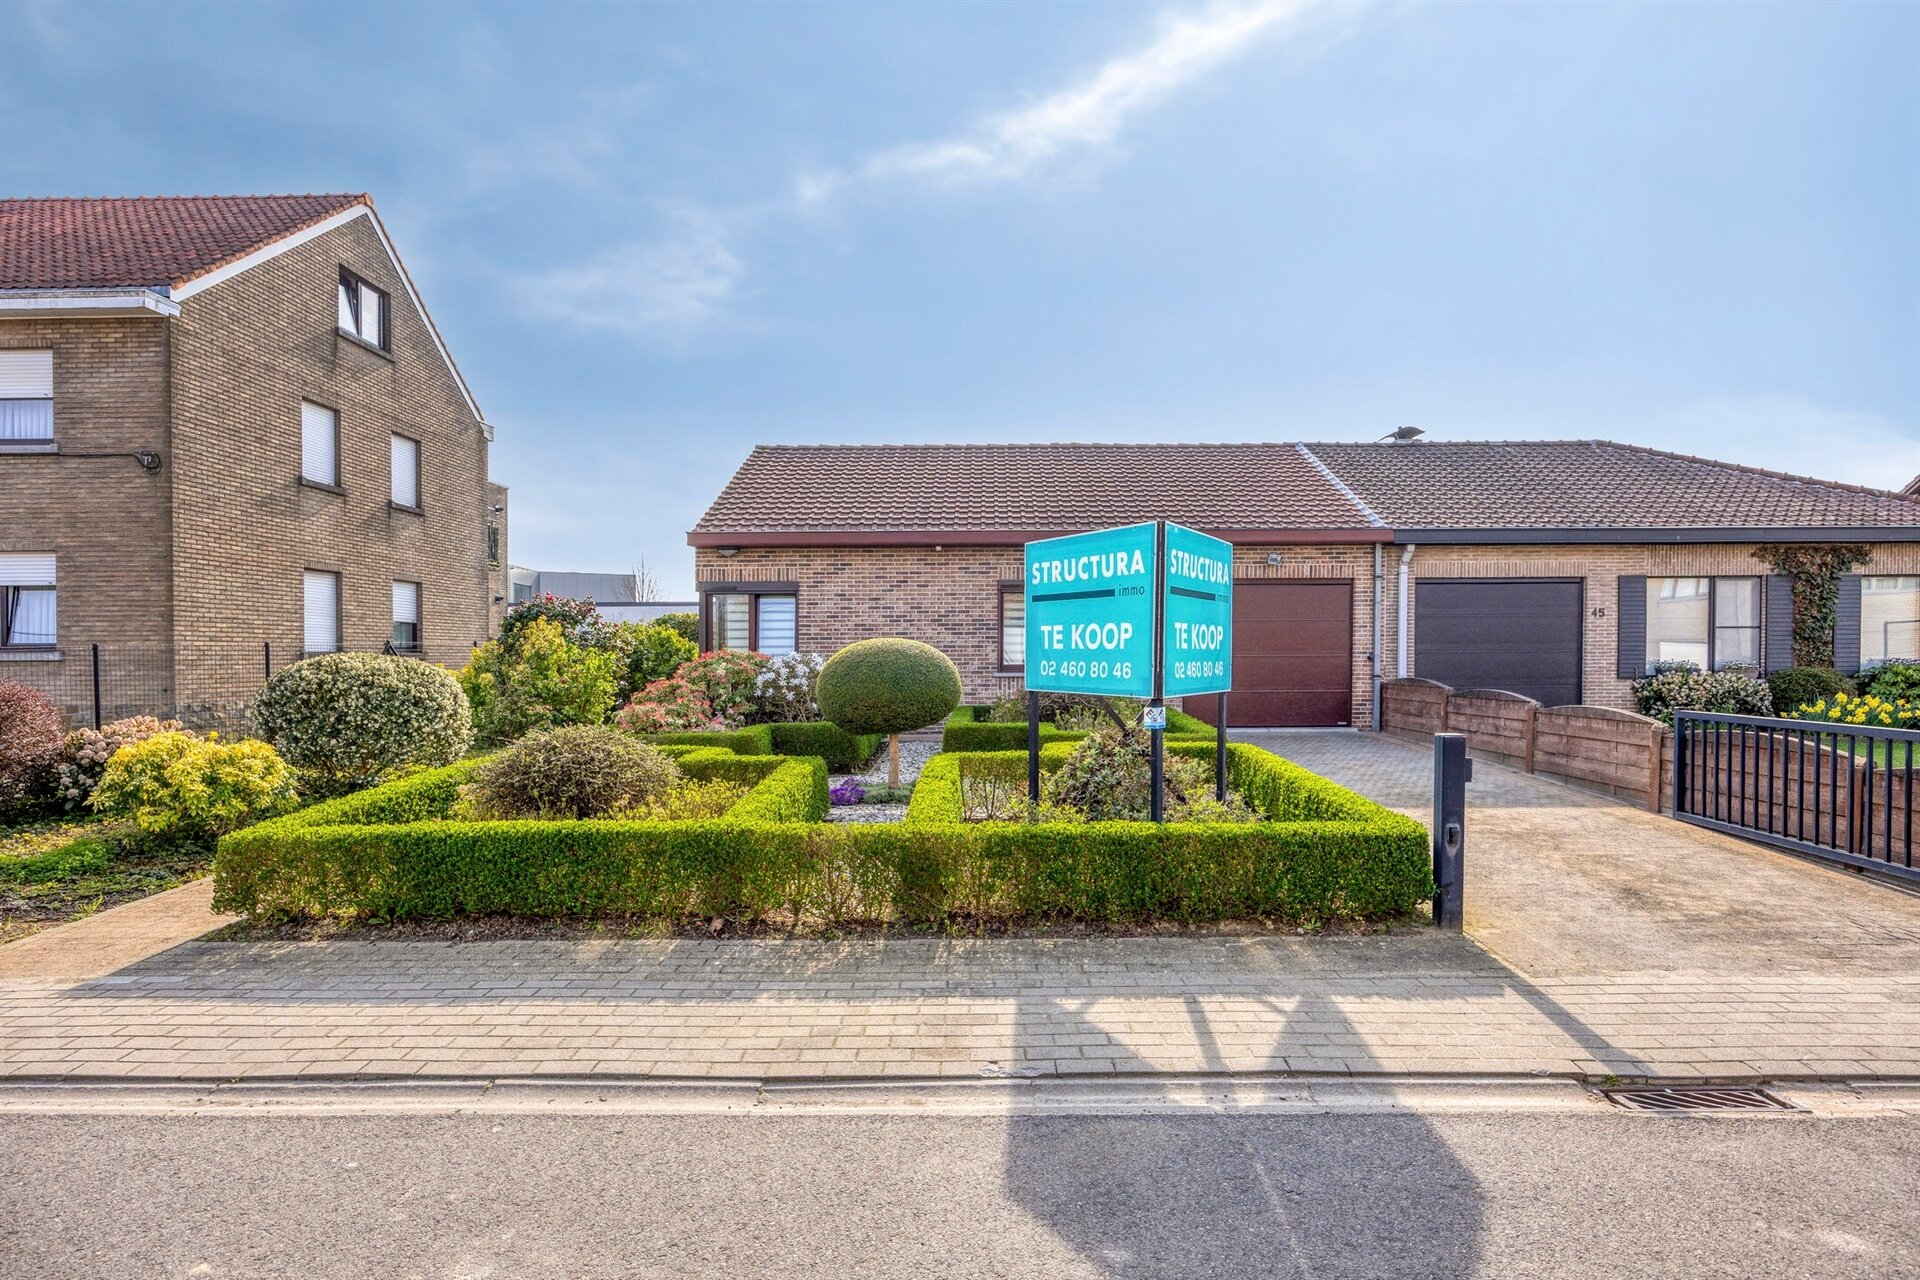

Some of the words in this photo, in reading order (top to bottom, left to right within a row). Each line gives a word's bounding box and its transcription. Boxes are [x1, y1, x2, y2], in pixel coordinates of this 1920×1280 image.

[1032, 549, 1145, 585] STRUCTURA
[1170, 549, 1229, 585] STRUCTURA
[1118, 583, 1145, 597] immo
[1592, 608, 1605, 618] 45
[1040, 624, 1064, 650] TE
[1071, 622, 1133, 650] KOOP
[1174, 621, 1188, 650] TE
[1191, 623, 1223, 650] KOOP
[1040, 660, 1057, 676] 02
[1060, 660, 1086, 677] 460
[1090, 661, 1109, 678] 80
[1112, 661, 1132, 679] 46
[1174, 661, 1185, 679] 02
[1186, 660, 1201, 678] 460
[1202, 660, 1213, 677] 80
[1214, 660, 1224, 677] 46
